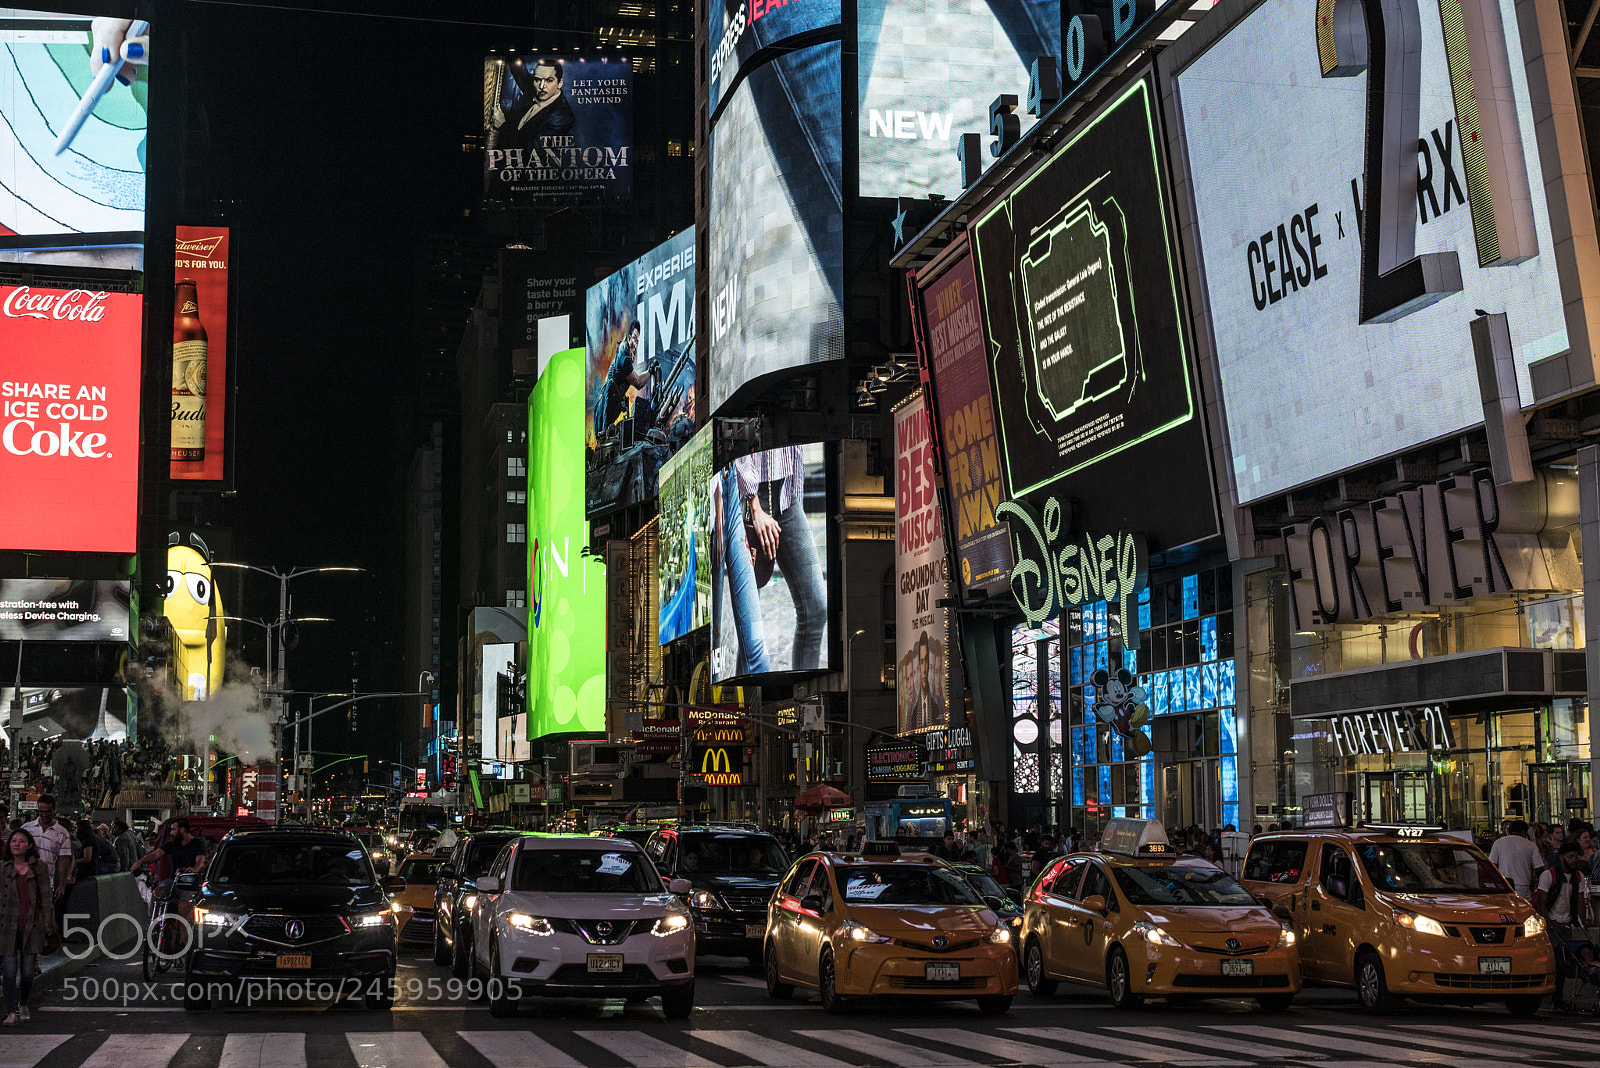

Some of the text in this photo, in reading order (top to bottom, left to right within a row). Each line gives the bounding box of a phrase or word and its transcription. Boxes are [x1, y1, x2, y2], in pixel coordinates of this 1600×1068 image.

[711, 3, 746, 85] EXPRESS
[573, 78, 627, 87] LET YOUR
[571, 87, 628, 97] FANTASIES
[577, 96, 622, 105] UNWIND
[868, 109, 954, 141] NEW
[540, 135, 575, 148] THE
[487, 146, 630, 171] PHANTOM
[500, 167, 617, 182] OF THE OPERA
[1247, 203, 1328, 311] CEASE
[192, 261, 207, 269] FOR
[209, 261, 227, 269] YOU.
[527, 277, 577, 288] Show your
[527, 288, 577, 299] taste buds
[527, 300, 563, 310] a berry
[711, 274, 738, 347] NEW
[1, 381, 107, 402] SHARE AN
[4, 401, 108, 421] ICE COLD
[945, 393, 993, 456] COME
[958, 479, 1001, 541] AWAY
[1281, 468, 1516, 632] FOREVER
[60, 600, 80, 609] with
[915, 589, 931, 615] DAY
[24, 611, 56, 620] Device
[57, 612, 101, 622] Charging.
[1331, 705, 1450, 757] FOREVER 21
[926, 731, 944, 751] GIFTS
[871, 750, 916, 764] ELECTRONICS
[872, 764, 917, 774] CAMERA LUGGAGE
[1397, 829, 1424, 837] 4Y27
